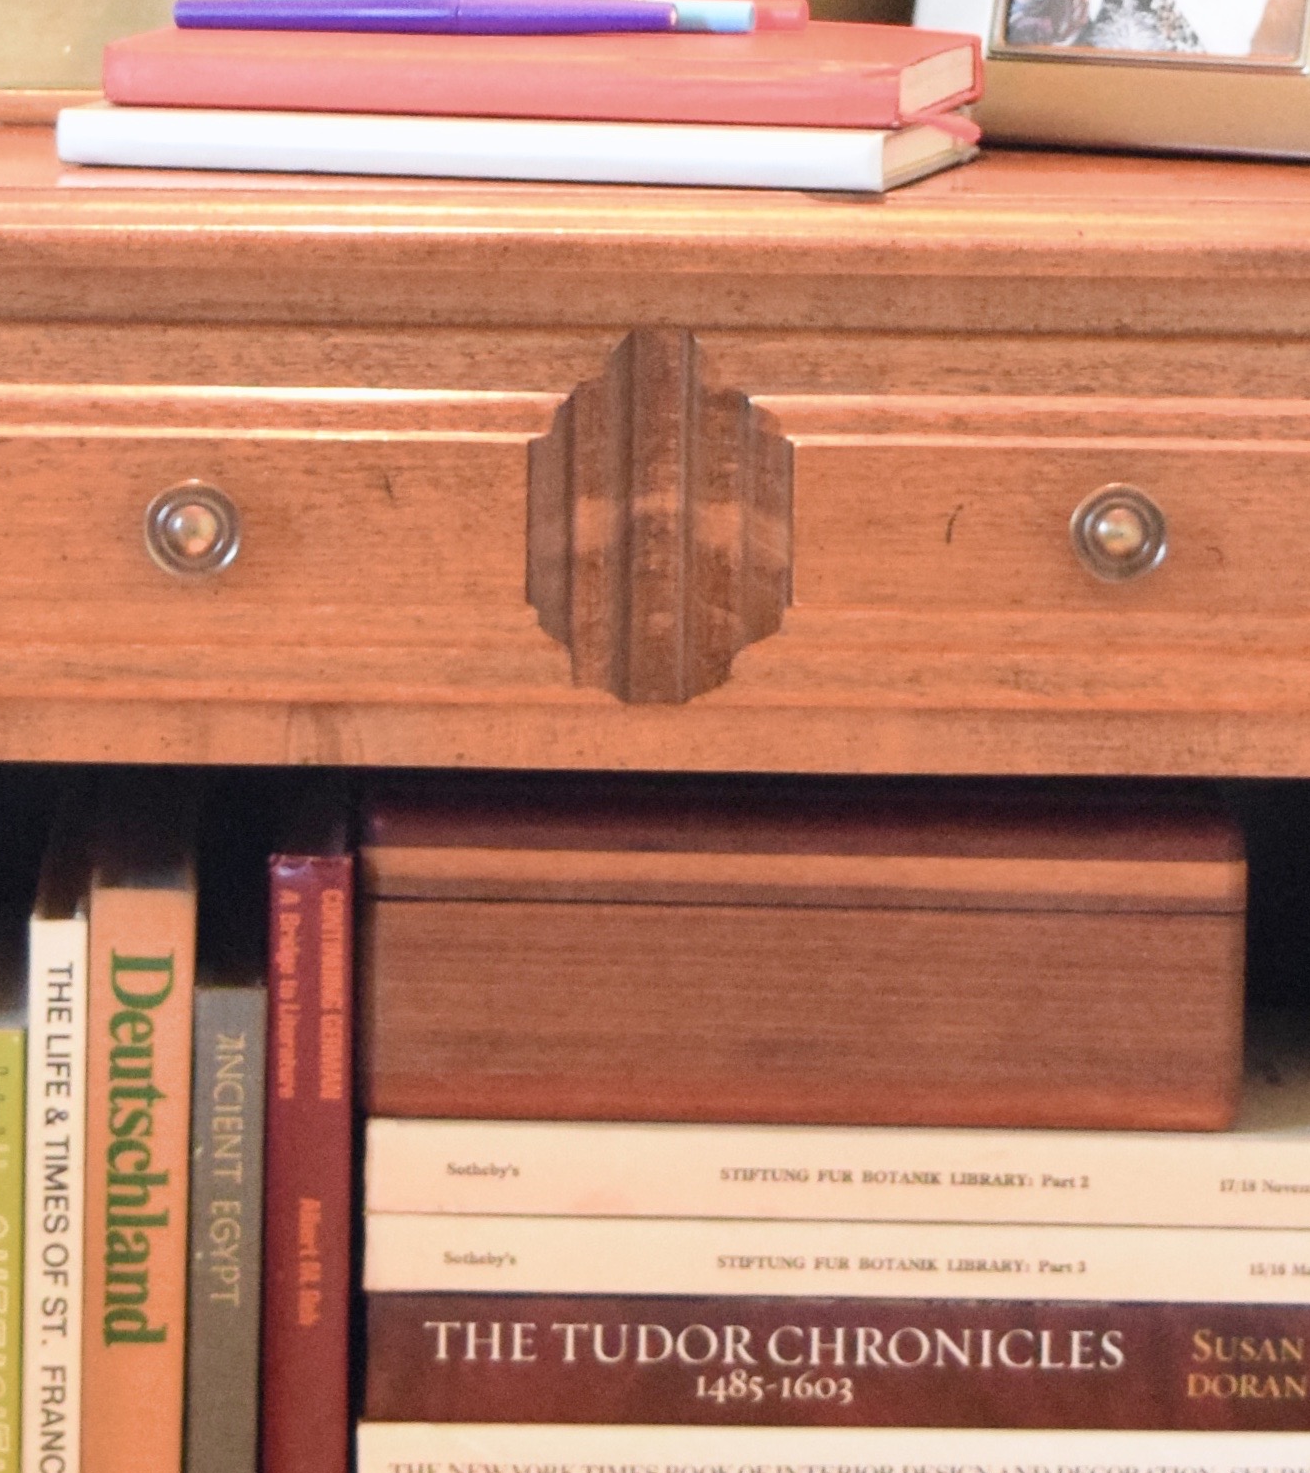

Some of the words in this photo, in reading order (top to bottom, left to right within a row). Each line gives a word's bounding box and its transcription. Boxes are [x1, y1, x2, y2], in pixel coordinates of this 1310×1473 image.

[47, 962, 73, 1023] THE
[44, 1035, 73, 1097] LIFE
[44, 1107, 69, 1126] &
[211, 1033, 246, 1184] ANCIENT
[103, 948, 175, 1347] Deutschland
[447, 1162, 520, 1177] Sotheby's
[42, 1134, 70, 1234] TIMES
[720, 1167, 809, 1183] STIFTUNG
[862, 1169, 943, 1186] BOTANIK
[1041, 1174, 1076, 1188] Part
[41, 1243, 69, 1287] OF
[209, 1200, 242, 1307] EGYPT
[443, 1251, 517, 1267] Sotheby's
[716, 1255, 805, 1270] STIFTUNG
[859, 1256, 938, 1271] BOTANIK
[1038, 1260, 1074, 1273] Part
[41, 1296, 68, 1346] ST.
[422, 1320, 538, 1362] THE
[551, 1322, 758, 1366] TUDOR
[767, 1325, 1125, 1370] CHRONICLES
[1192, 1328, 1305, 1362] SUSAN
[695, 1368, 854, 1404] 1485-1603
[1187, 1373, 1308, 1400] DORAN
